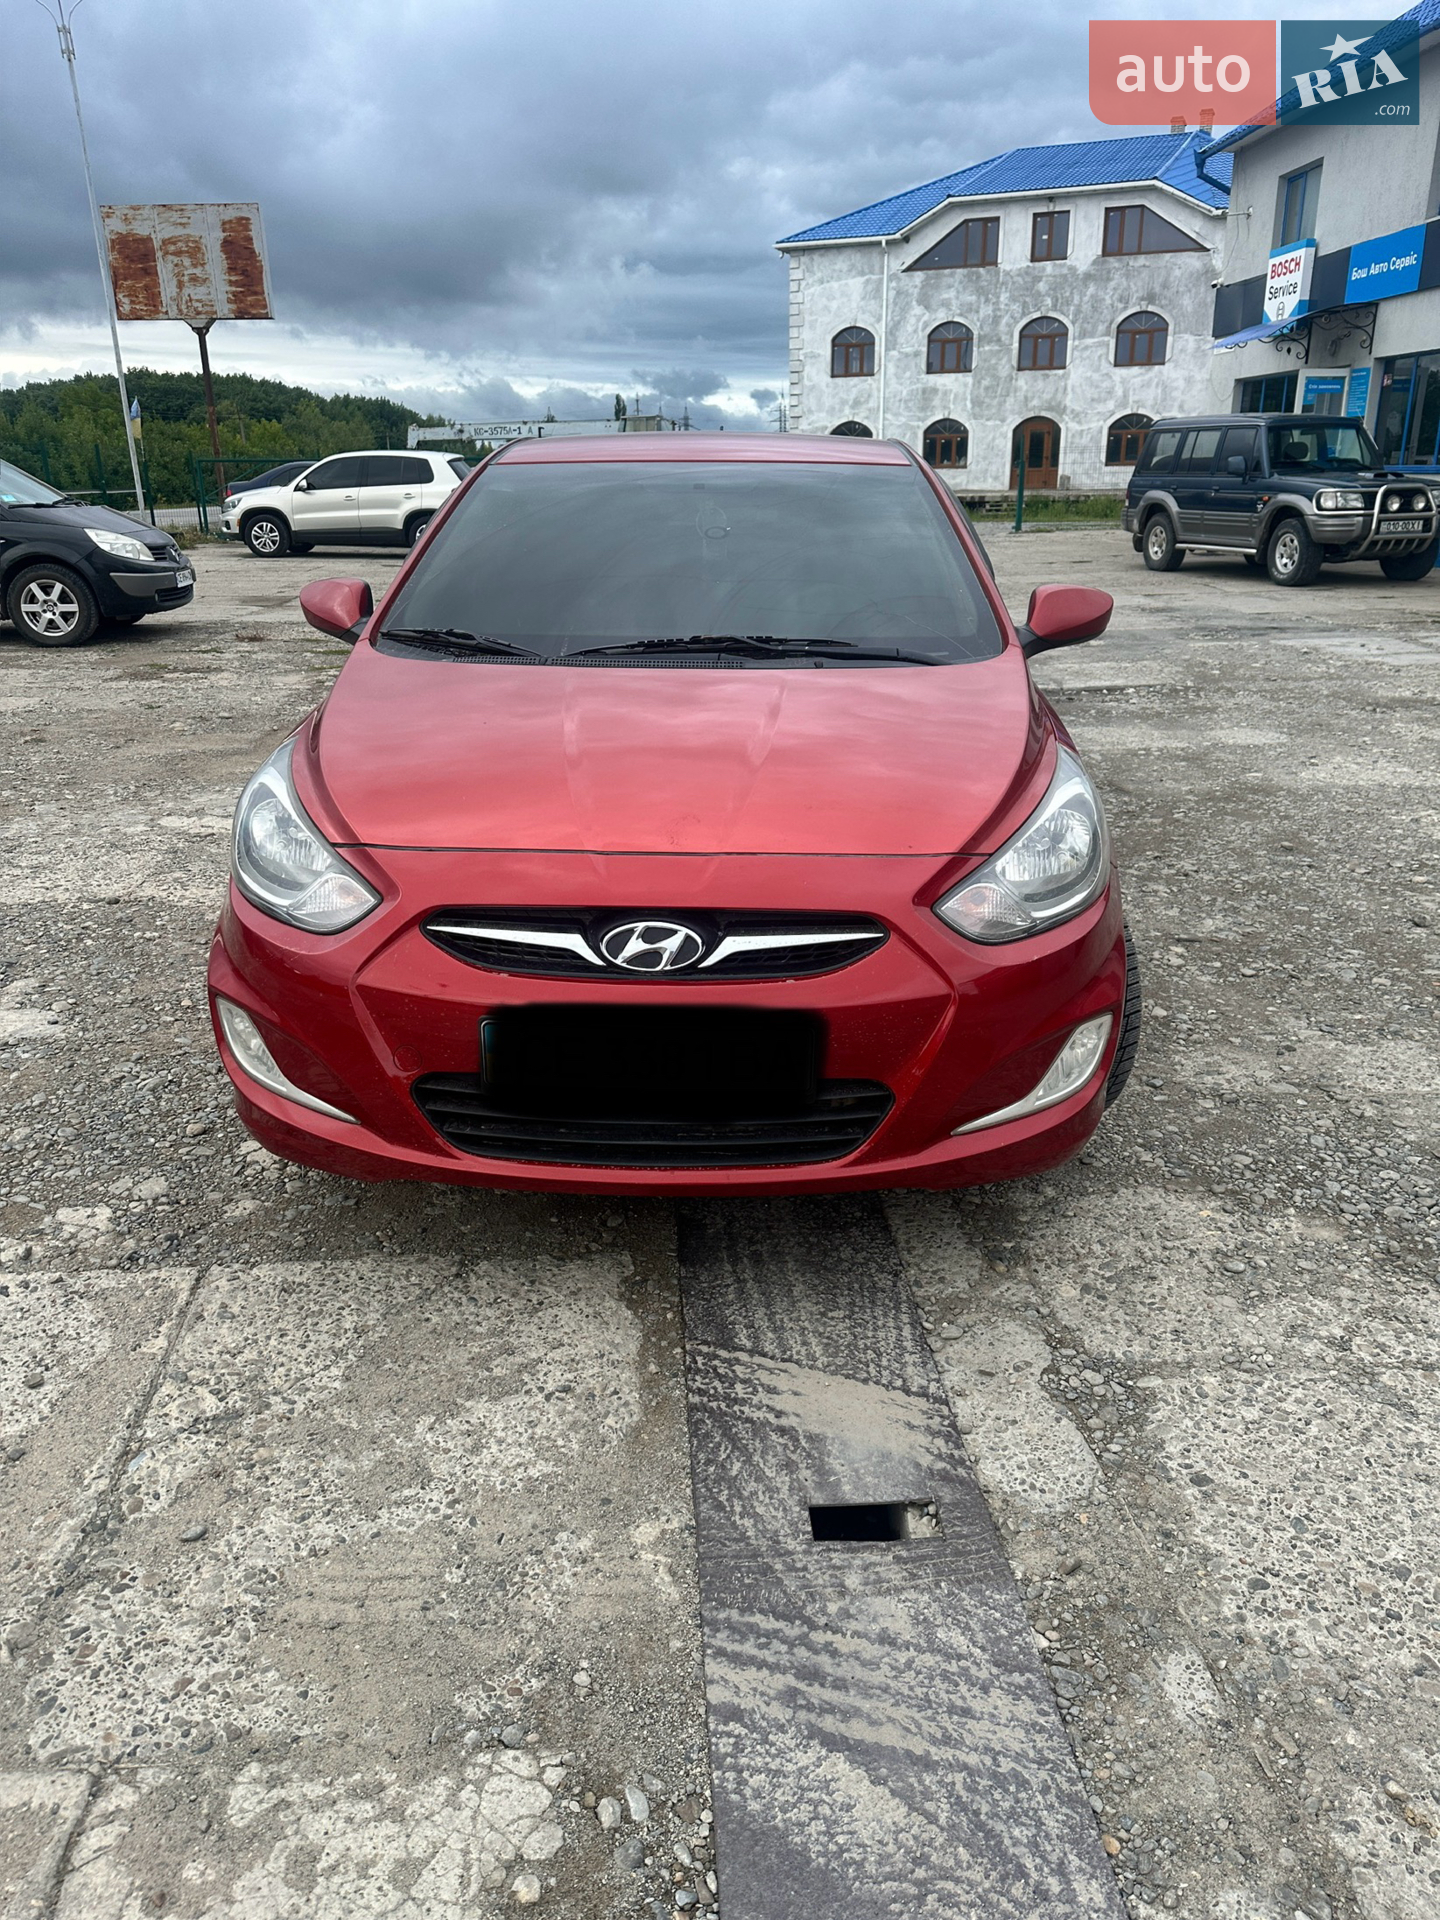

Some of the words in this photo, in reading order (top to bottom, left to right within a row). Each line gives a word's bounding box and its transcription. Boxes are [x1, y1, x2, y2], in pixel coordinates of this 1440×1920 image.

[1270, 255, 1302, 280] BOSCH
[1351, 267, 1368, 281] Бош
[1369, 262, 1388, 276] Авто
[1390, 251, 1418, 271] Сервіс
[1268, 280, 1298, 301] Service
